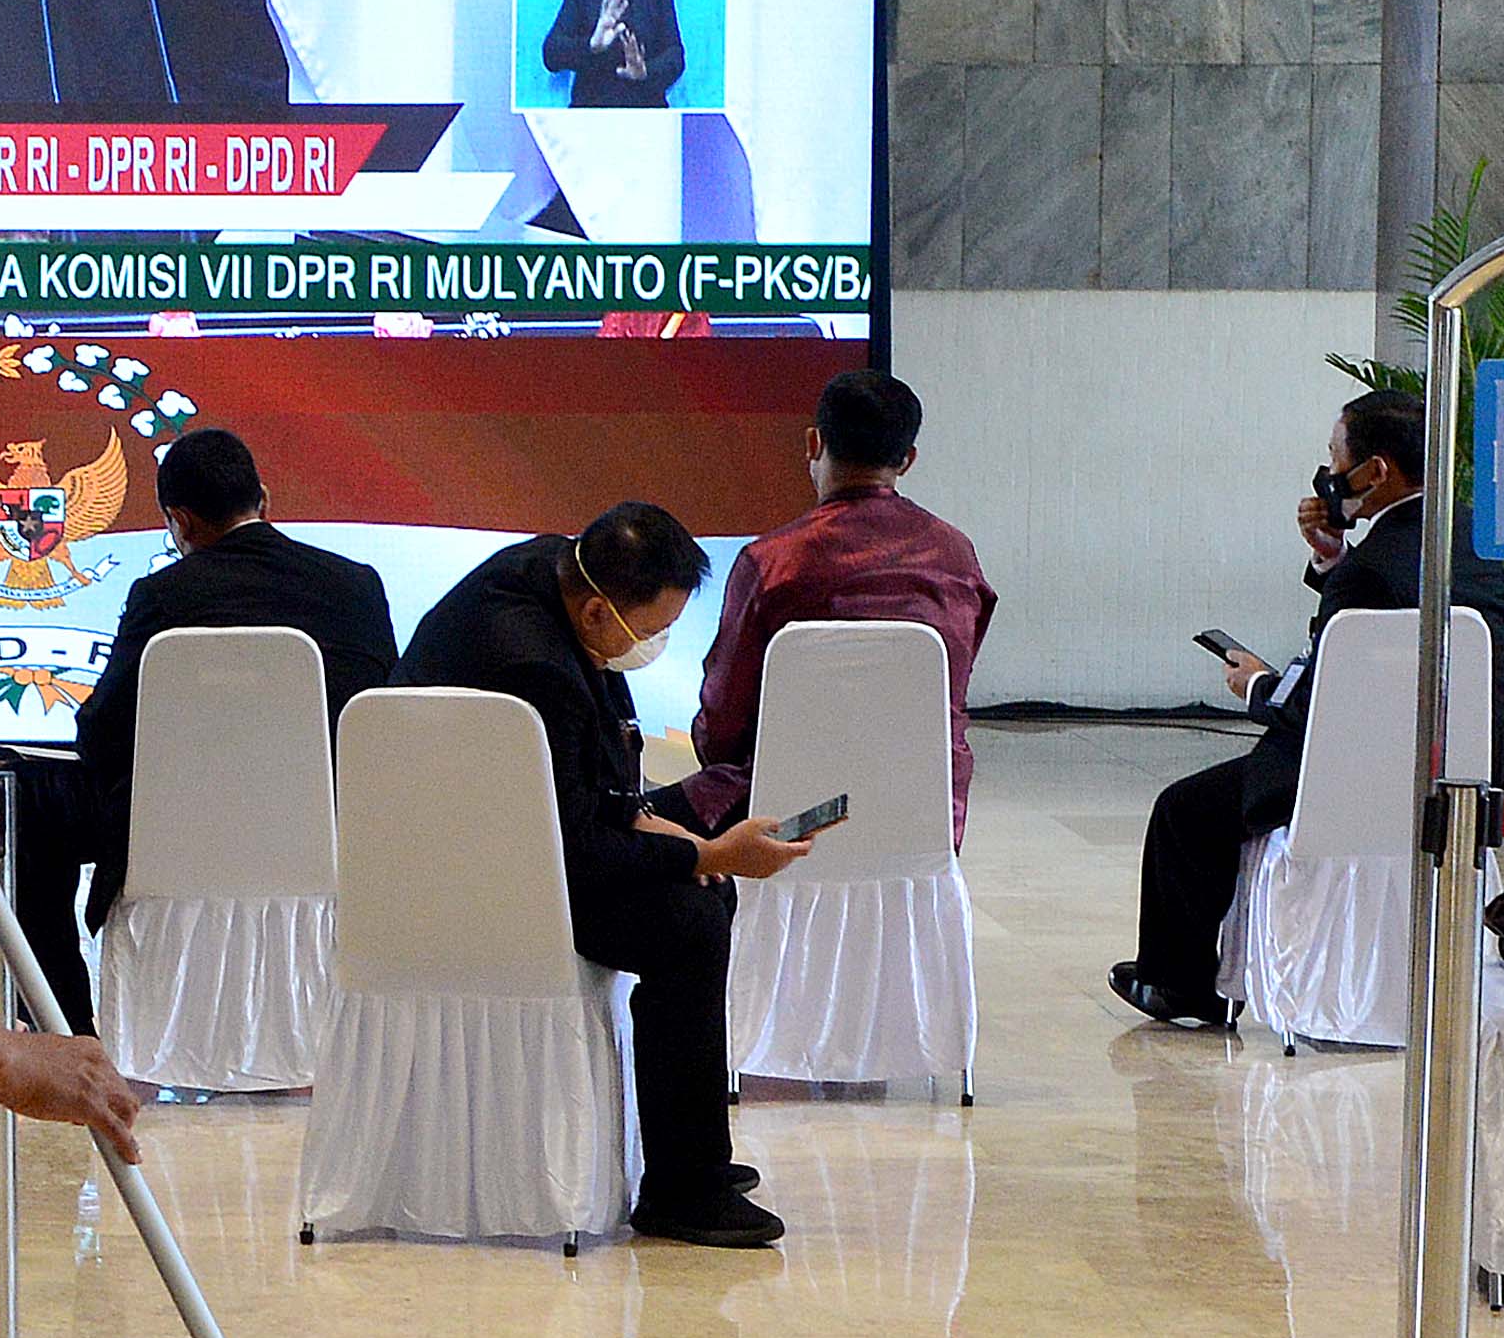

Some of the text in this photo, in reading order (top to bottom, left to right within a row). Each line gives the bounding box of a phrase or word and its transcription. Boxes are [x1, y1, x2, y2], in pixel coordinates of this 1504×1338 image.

[27, 136, 58, 192] RI
[88, 136, 156, 193] DPR
[165, 136, 196, 193] RI
[226, 136, 294, 193] DPD
[304, 136, 335, 193] RI
[40, 253, 187, 299] KOMISI
[200, 254, 252, 299] VII
[267, 254, 356, 299] DPR
[370, 254, 411, 300] RI
[426, 254, 665, 300] MULYANTO
